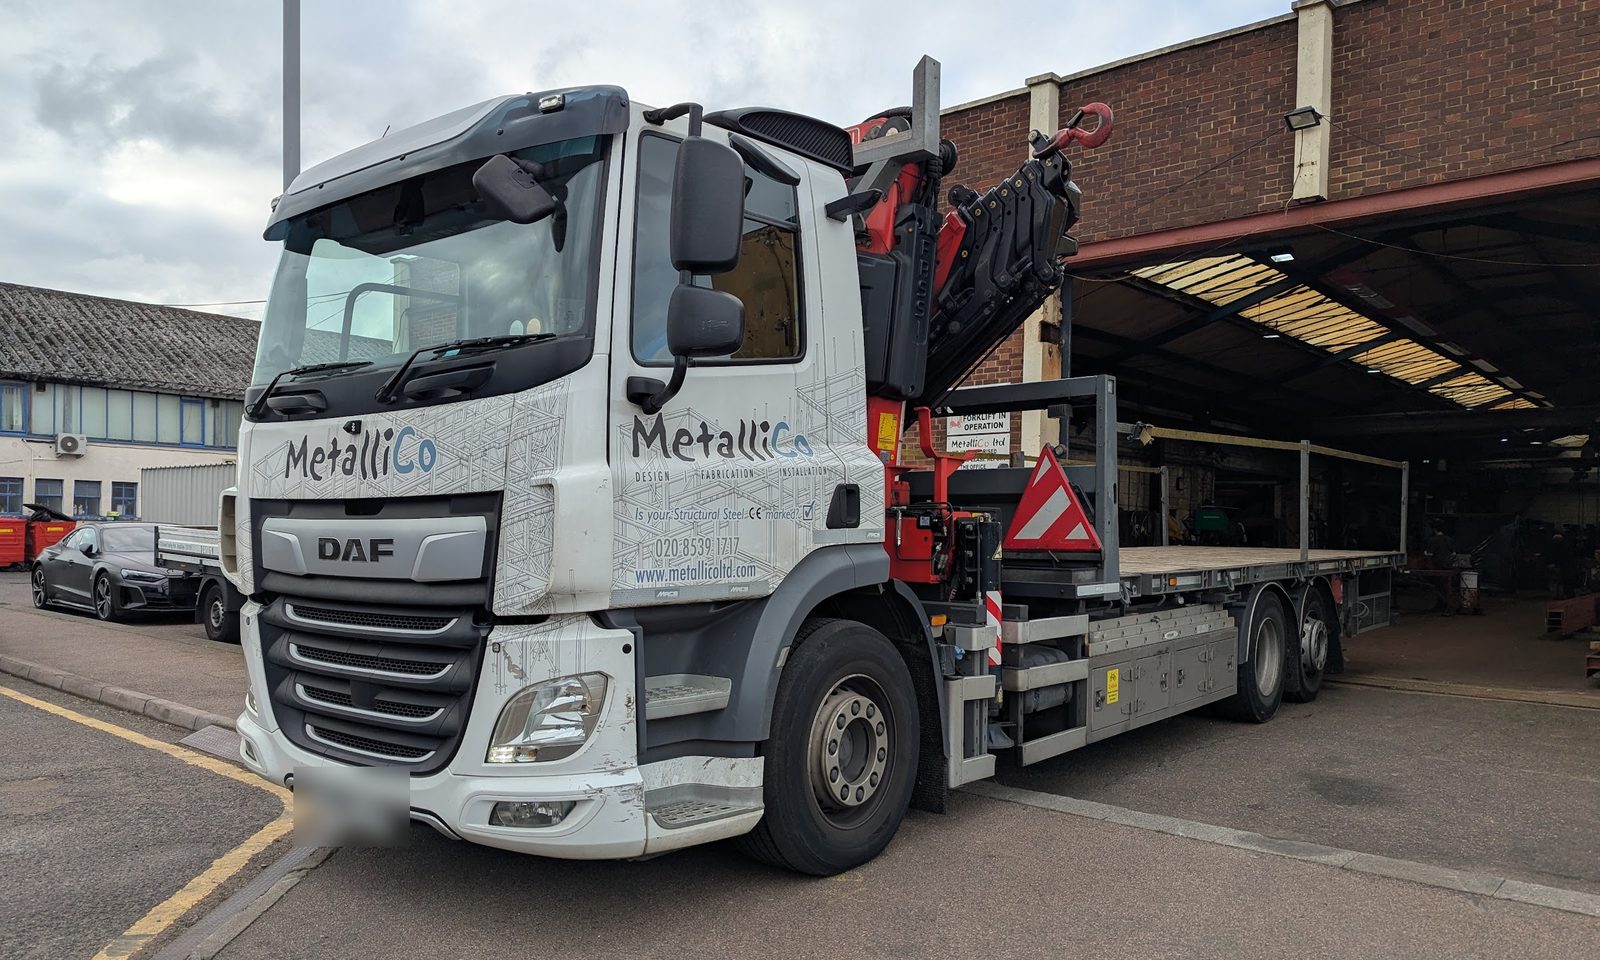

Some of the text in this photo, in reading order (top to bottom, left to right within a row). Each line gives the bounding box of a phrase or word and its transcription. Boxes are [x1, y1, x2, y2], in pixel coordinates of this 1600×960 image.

[632, 412, 815, 462] MetalliCo
[964, 422, 1003, 430] OPERATION
[285, 425, 437, 481] MetalliCo
[951, 438, 990, 448] MetalliCo
[635, 466, 828, 482] DESIGN FABRICATION INSTALLATION
[635, 507, 644, 521] Is
[647, 511, 670, 524] your
[673, 507, 720, 521] Structural
[723, 507, 745, 520] Steel
[765, 507, 800, 520] marked?
[318, 537, 394, 563] DAF
[655, 536, 740, 558] 020 8539 1717
[635, 559, 756, 583] www.metallicoltd.com
